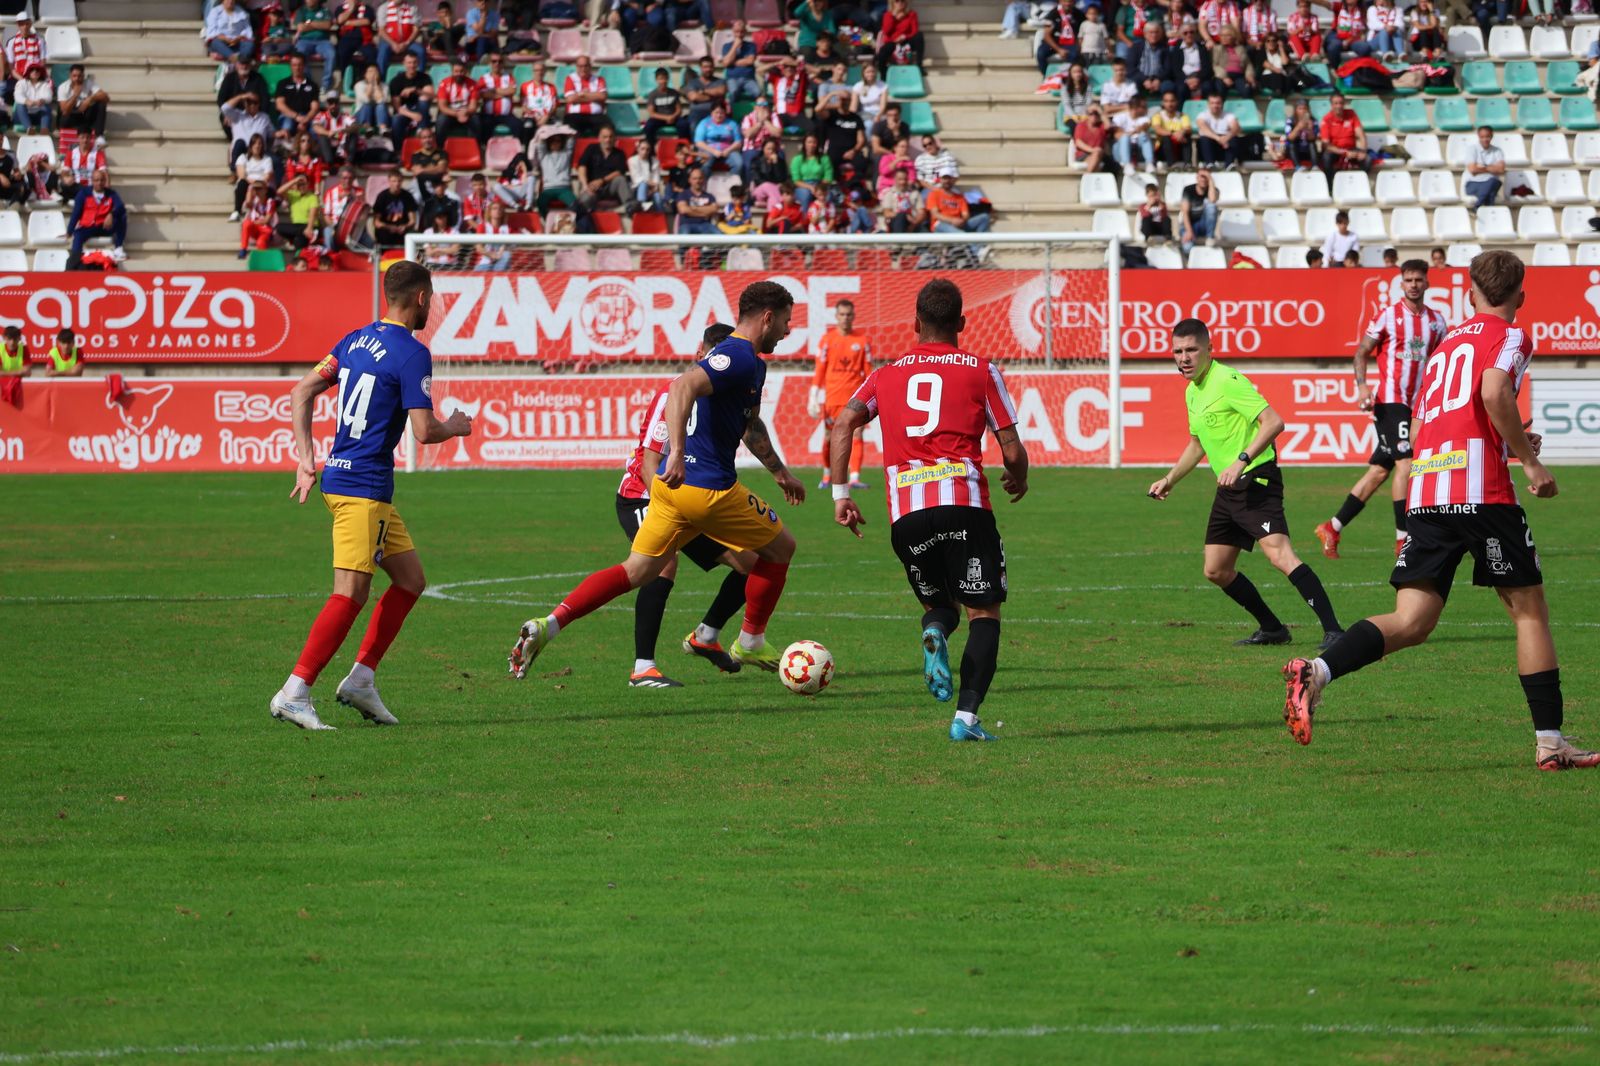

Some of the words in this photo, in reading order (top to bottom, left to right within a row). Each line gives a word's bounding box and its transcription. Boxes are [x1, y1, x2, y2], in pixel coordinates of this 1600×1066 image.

[1191, 291, 1326, 329] ÓPTICO
[129, 334, 139, 348] Y
[147, 333, 256, 348] JAMONES
[512, 390, 583, 410] bodegas
[1424, 351, 1475, 424] 20
[336, 367, 377, 440] 14
[905, 372, 944, 438] 9
[1398, 421, 1409, 439] 6
[959, 580, 992, 591] ZAMORA
